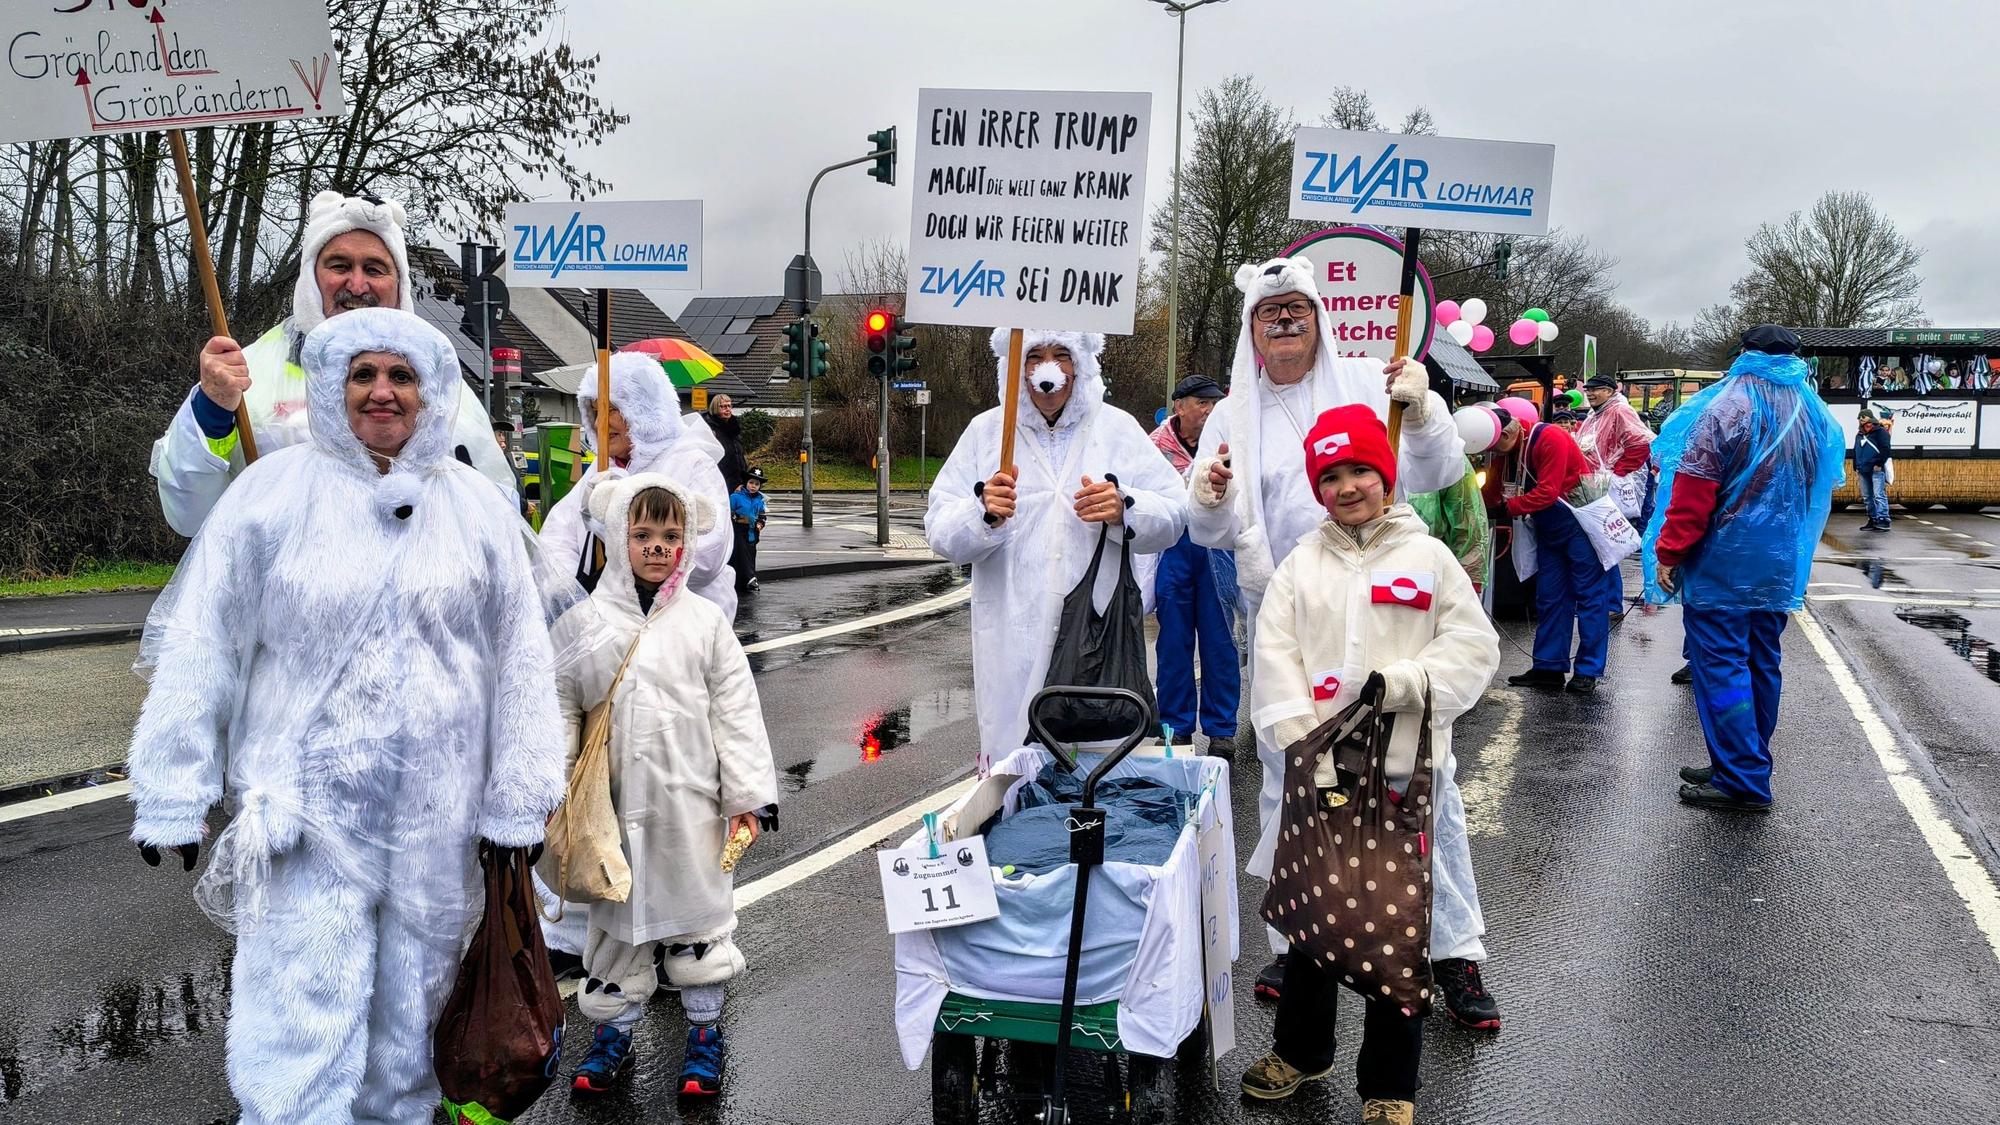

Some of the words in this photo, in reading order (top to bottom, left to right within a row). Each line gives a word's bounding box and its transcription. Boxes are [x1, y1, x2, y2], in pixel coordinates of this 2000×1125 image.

[9, 30, 162, 79] Grönland
[168, 32, 209, 71] den
[94, 79, 293, 122] Grönländern
[1054, 111, 1138, 154] TRUMP
[928, 166, 987, 196] MACHT
[1008, 179, 1035, 198] WELT
[1040, 179, 1067, 198] GANZ
[1073, 171, 1133, 200] KRANK
[1302, 143, 1429, 214] ZWAR
[1436, 181, 1534, 206] LOHMAR
[925, 212, 968, 240] DOCH
[513, 212, 607, 279] ZWAR
[613, 244, 689, 262] LOHMAR
[920, 259, 1006, 308] ZWAR
[1060, 267, 1123, 308] DANK
[1327, 261, 1357, 282] Et
[1901, 410, 1972, 419] Dorfgemeinschaft
[1906, 426, 1932, 434] Scheid
[1934, 426, 1952, 434] 1970
[913, 868, 958, 880] Zugnummer
[921, 884, 961, 912] 11
